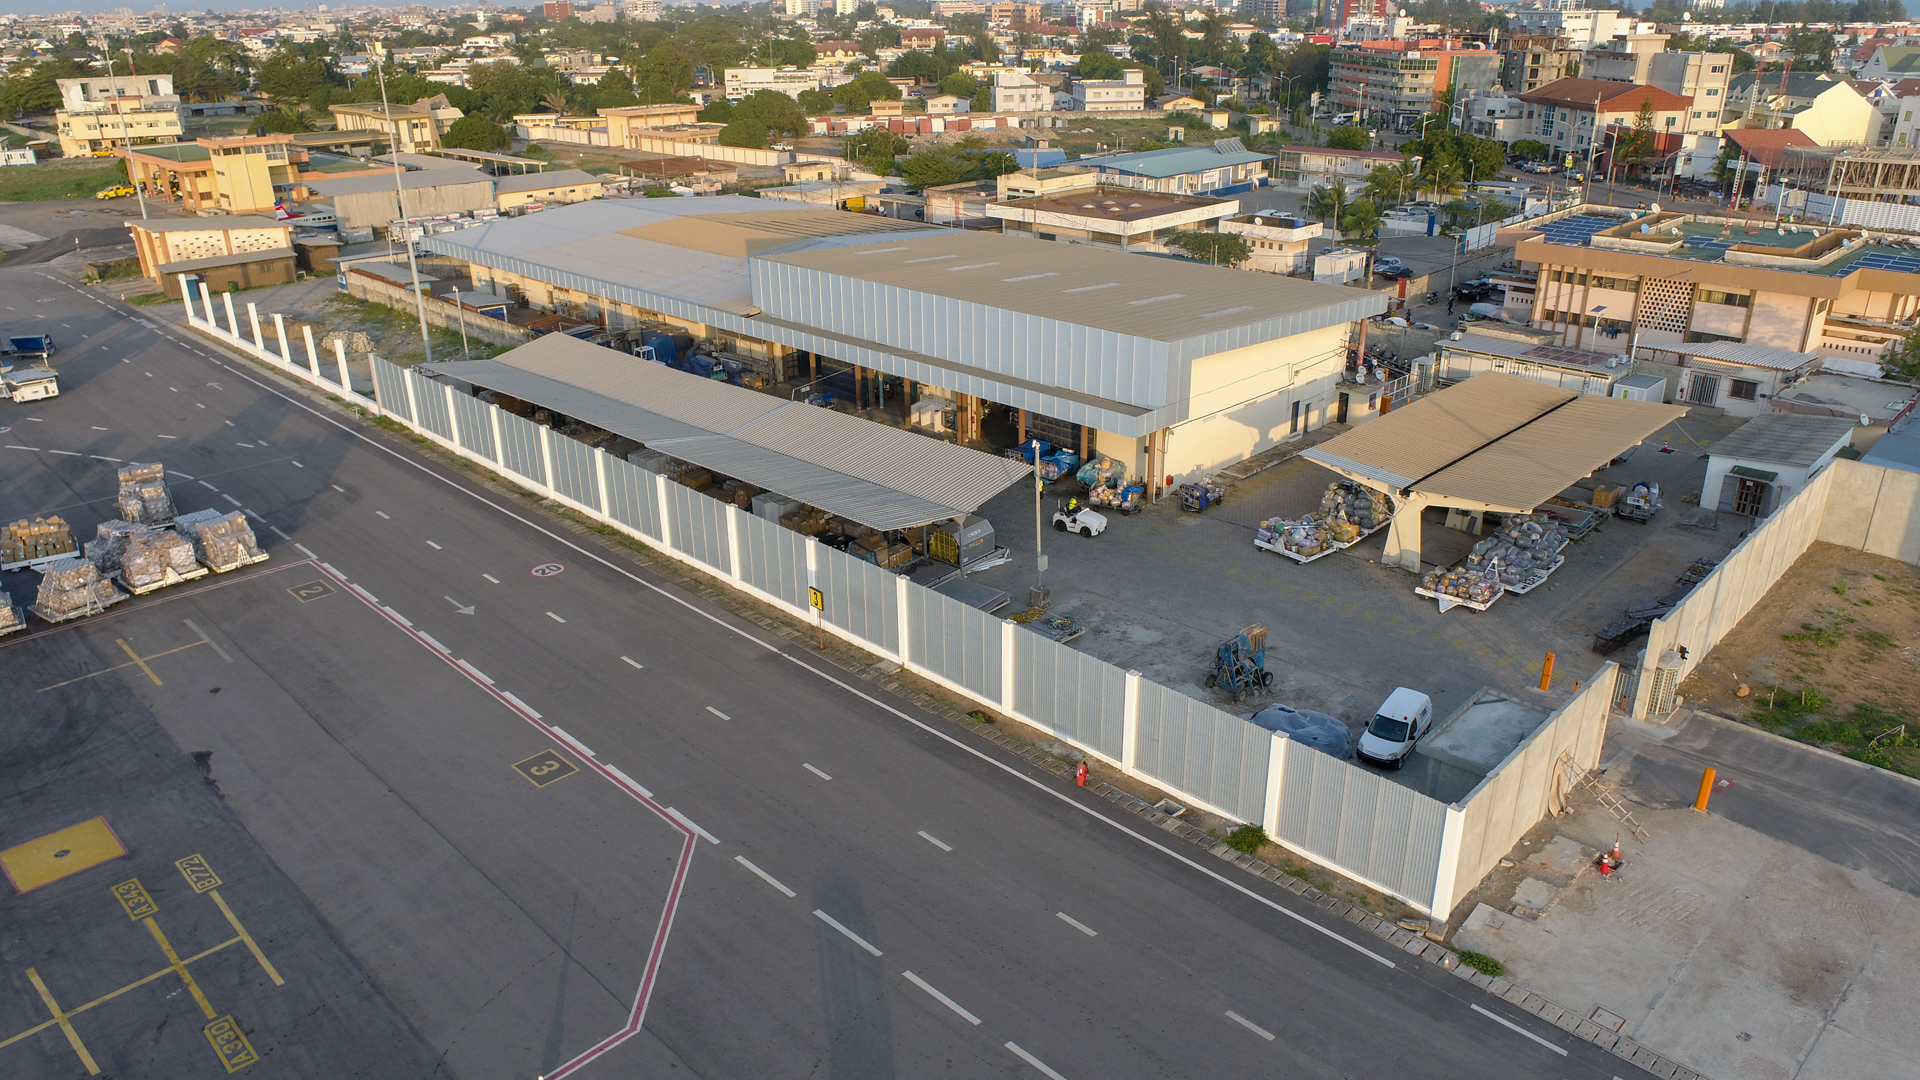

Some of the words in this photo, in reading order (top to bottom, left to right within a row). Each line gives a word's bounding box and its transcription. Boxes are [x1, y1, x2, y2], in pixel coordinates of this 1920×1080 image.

[534, 564, 562, 576] 20
[299, 586, 324, 597] 2
[813, 591, 819, 607] 3
[530, 760, 560, 777] 3
[180, 857, 215, 891] B772
[118, 882, 153, 914] A343
[208, 1020, 252, 1066] A330
